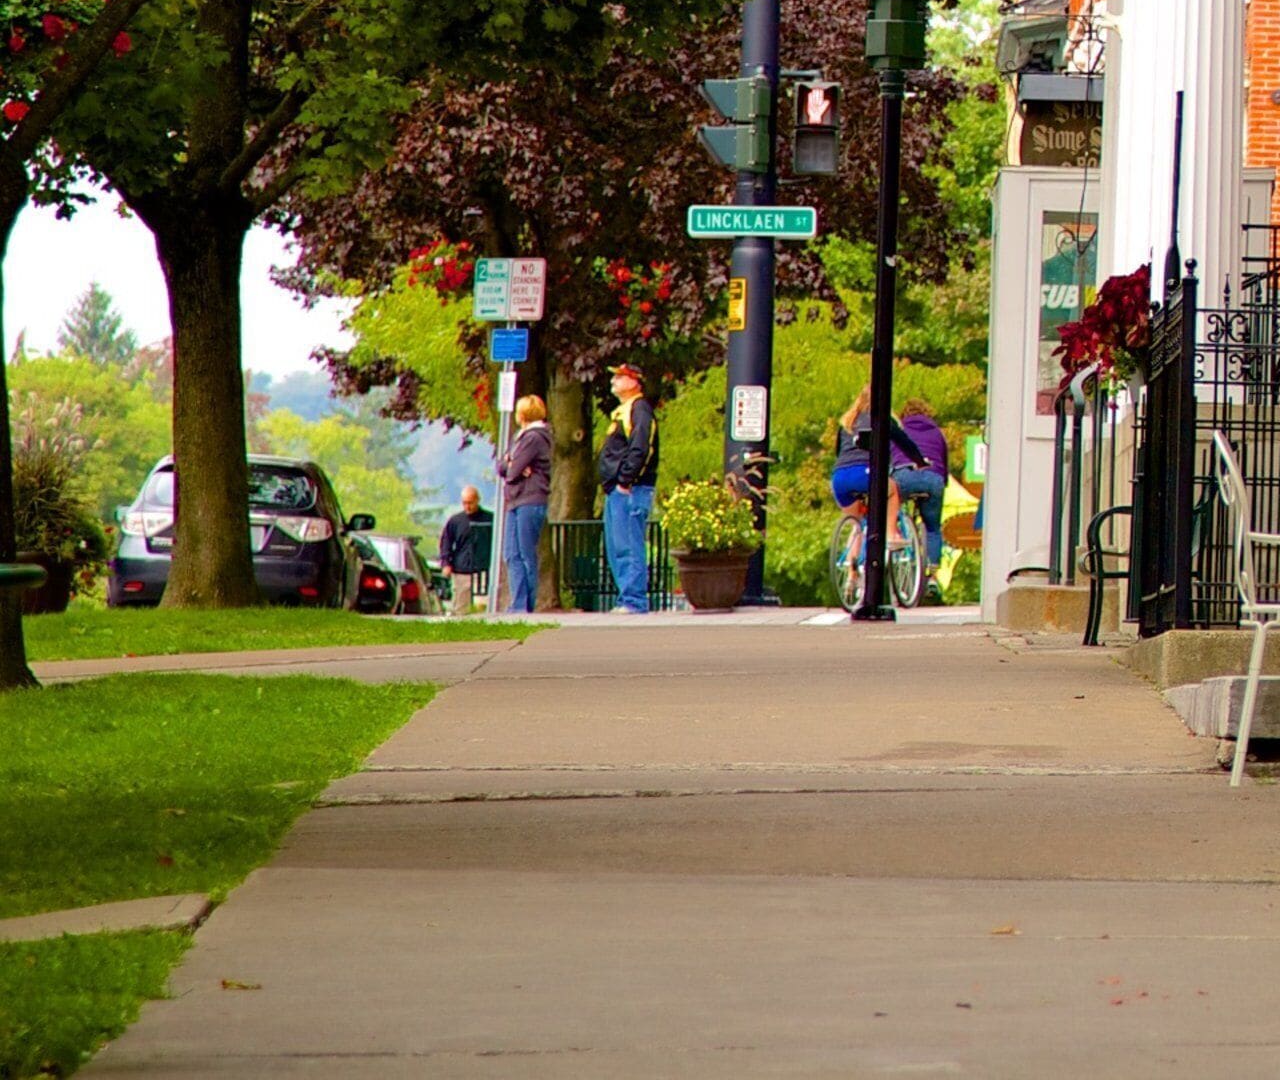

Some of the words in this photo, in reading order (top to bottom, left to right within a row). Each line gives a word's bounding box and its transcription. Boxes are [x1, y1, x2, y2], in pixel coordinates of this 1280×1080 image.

[1031, 124, 1086, 155] Stone
[697, 211, 785, 229] LINCKLAEN
[478, 263, 487, 279] 2
[521, 263, 535, 275] NO
[513, 276, 541, 284] STANDING
[512, 297, 538, 305] CORNER
